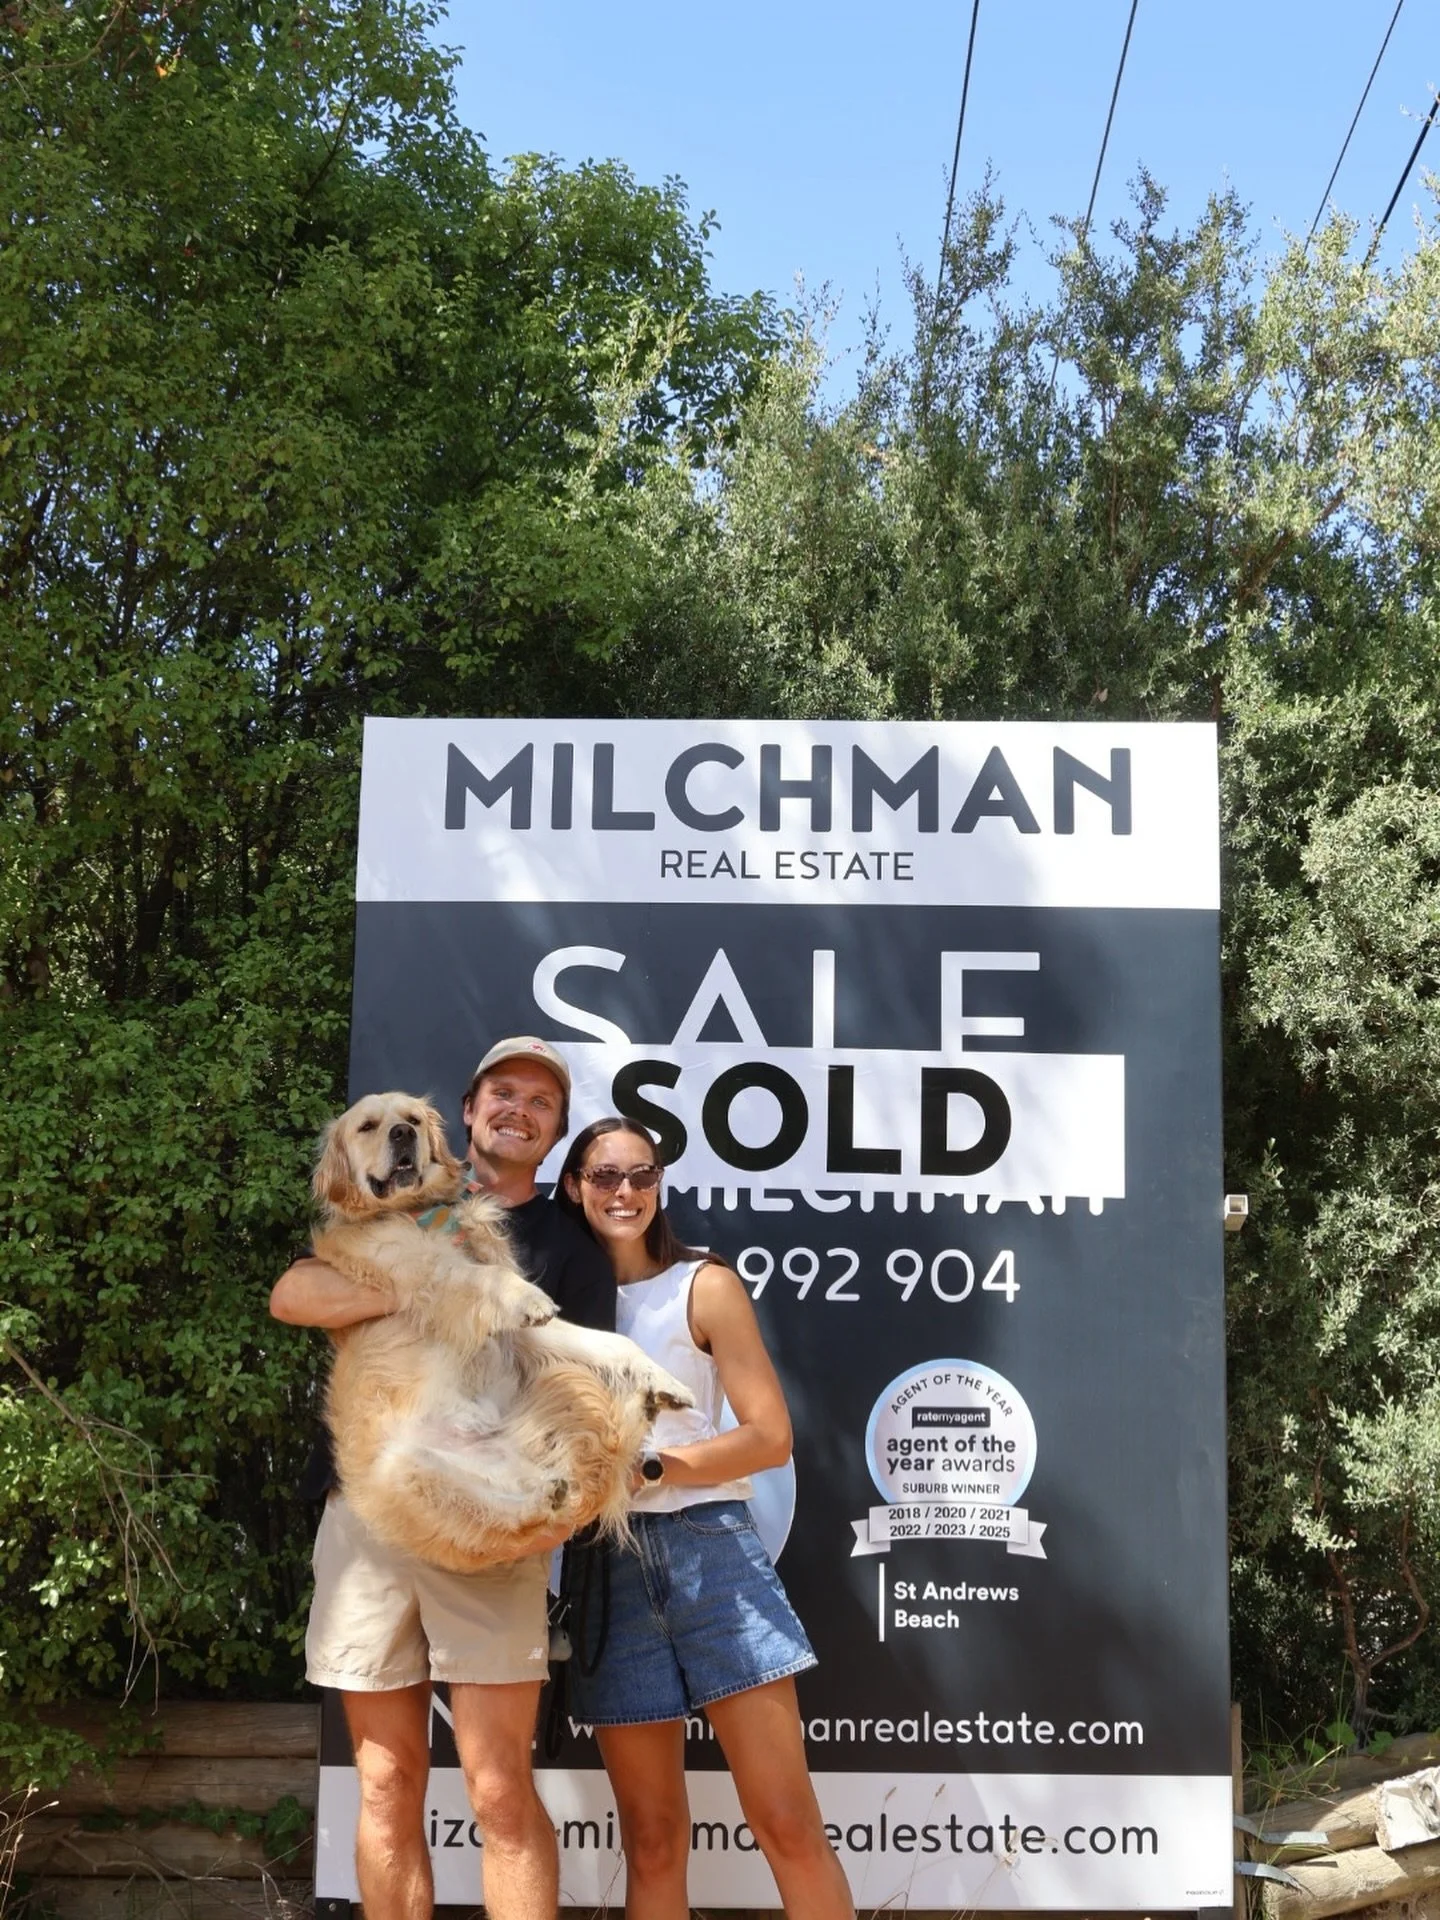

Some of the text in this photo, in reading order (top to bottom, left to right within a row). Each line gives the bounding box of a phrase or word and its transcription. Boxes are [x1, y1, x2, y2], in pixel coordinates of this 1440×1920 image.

[444, 742, 1132, 836] MILCHMAN
[660, 849, 914, 881] REAL ESTATE
[611, 1059, 1012, 1177] SOLD
[736, 1246, 1021, 1304] 992 904
[891, 1374, 1013, 1417] AGENT OF THE YEAR
[917, 1411, 986, 1425] ratemyagent
[886, 1434, 1016, 1455] agent of the
[886, 1454, 1015, 1476] year awards
[902, 1482, 1000, 1495] SUBURB WINNER
[888, 1506, 921, 1521] 2018
[933, 1506, 967, 1519] 2020
[979, 1508, 1011, 1521] 2021
[889, 1523, 922, 1537] 2022
[934, 1523, 966, 1536] 2023
[979, 1524, 1011, 1539] 2025
[893, 1580, 1020, 1601] St Andrews
[894, 1609, 960, 1629] Beach
